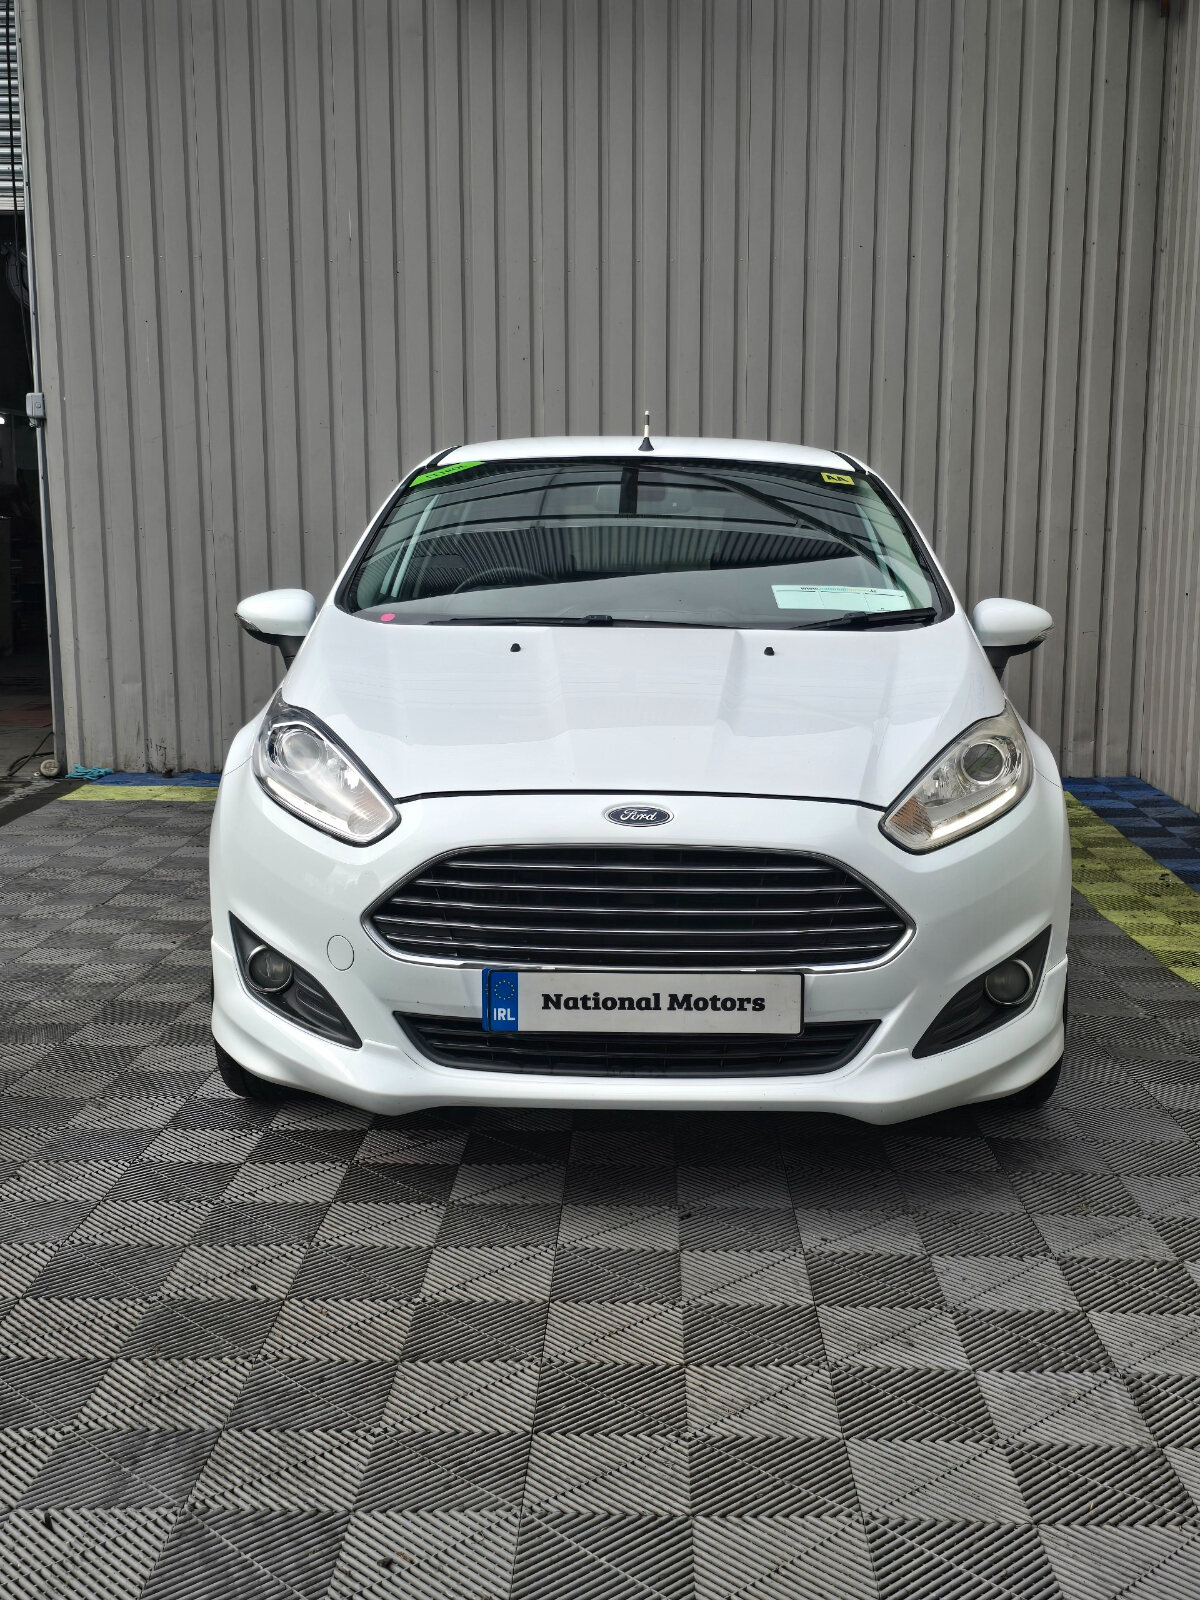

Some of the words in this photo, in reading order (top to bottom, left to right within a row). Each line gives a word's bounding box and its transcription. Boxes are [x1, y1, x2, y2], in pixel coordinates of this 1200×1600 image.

[620, 808, 658, 821] Ford
[541, 992, 662, 1011] National
[667, 993, 766, 1012] Motors
[493, 1008, 516, 1022] IRL
